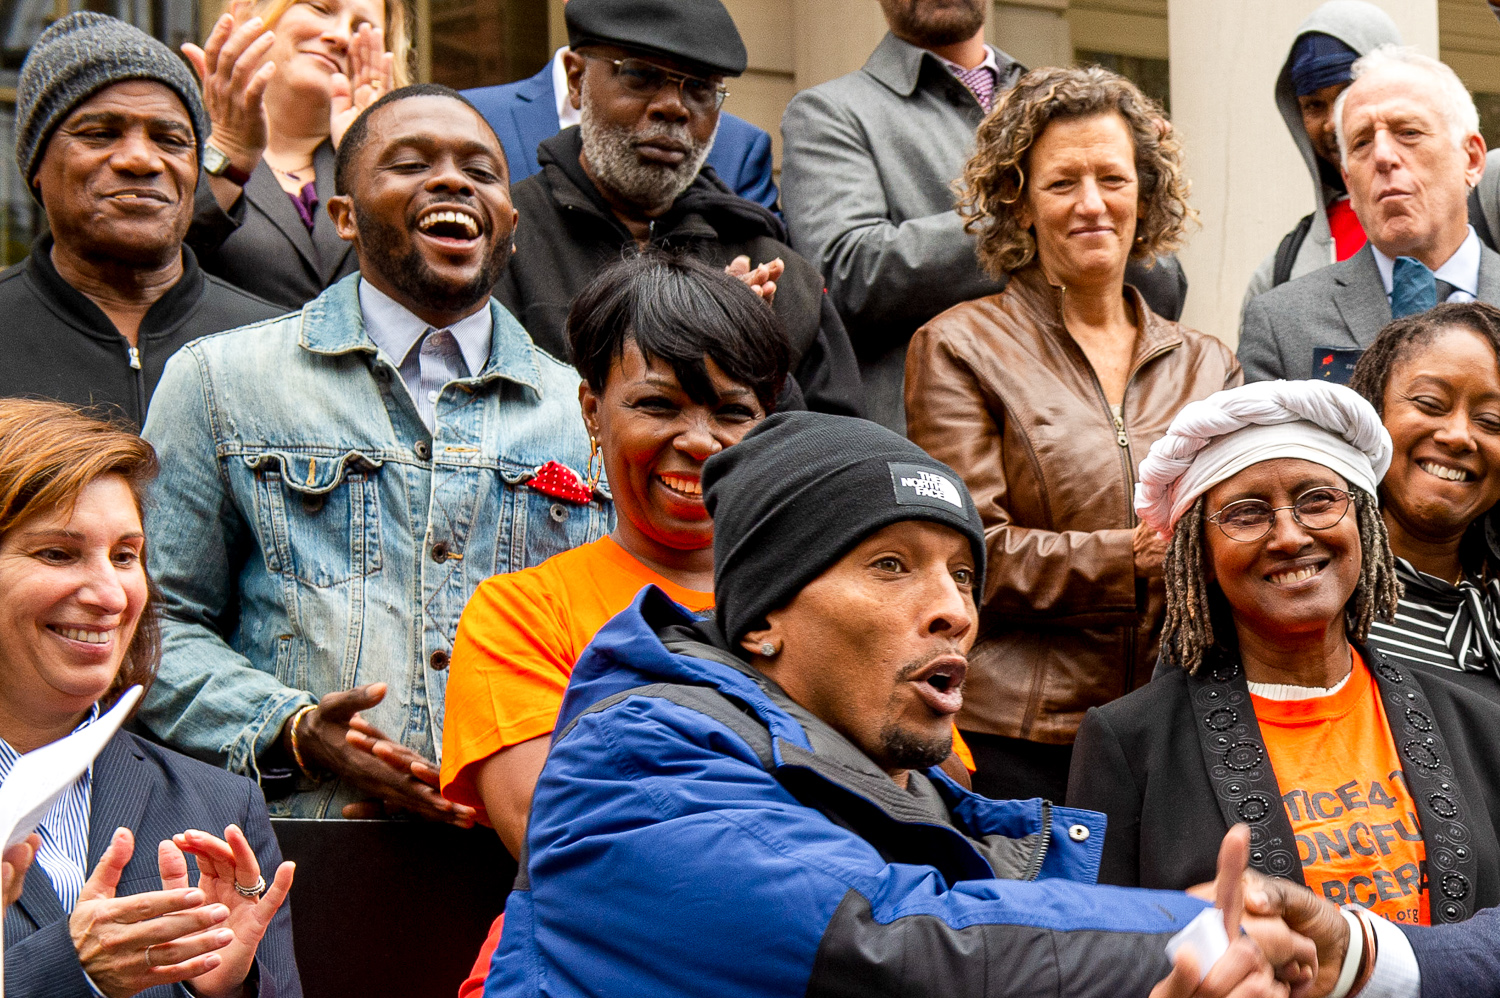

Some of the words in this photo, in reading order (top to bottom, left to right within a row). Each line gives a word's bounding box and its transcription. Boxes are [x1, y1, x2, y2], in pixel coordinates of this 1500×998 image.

[900, 477, 941, 491] NORTH
[917, 471, 942, 483] THE
[915, 486, 945, 500] FACE
